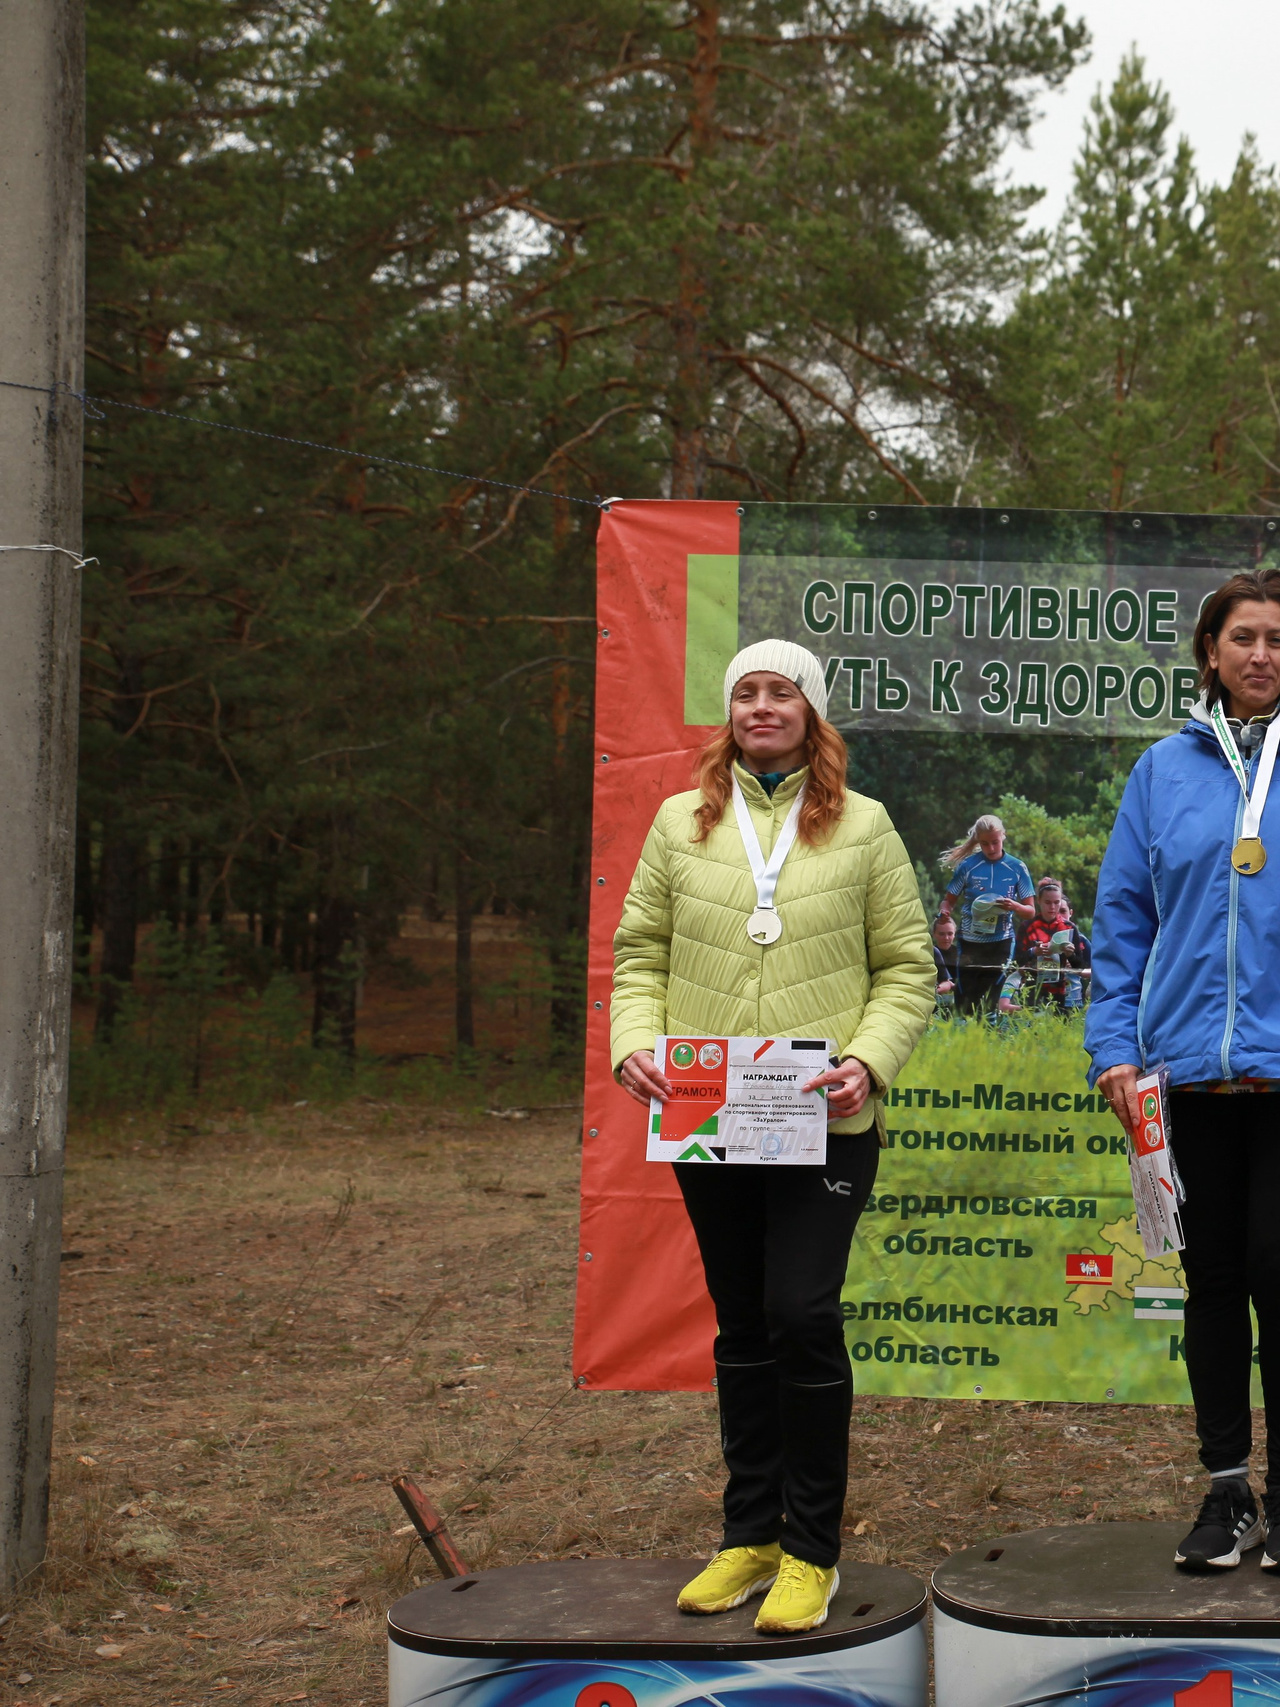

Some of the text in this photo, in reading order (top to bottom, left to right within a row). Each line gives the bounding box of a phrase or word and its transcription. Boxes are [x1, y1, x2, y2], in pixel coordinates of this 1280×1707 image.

[802, 580, 1178, 644] СПОРТИВНОЕ
[932, 659, 962, 714] К
[863, 1193, 1097, 1220] вердловская
[883, 1229, 1034, 1258] область
[840, 1296, 1059, 1327] елябинская
[851, 1336, 1001, 1367] область
